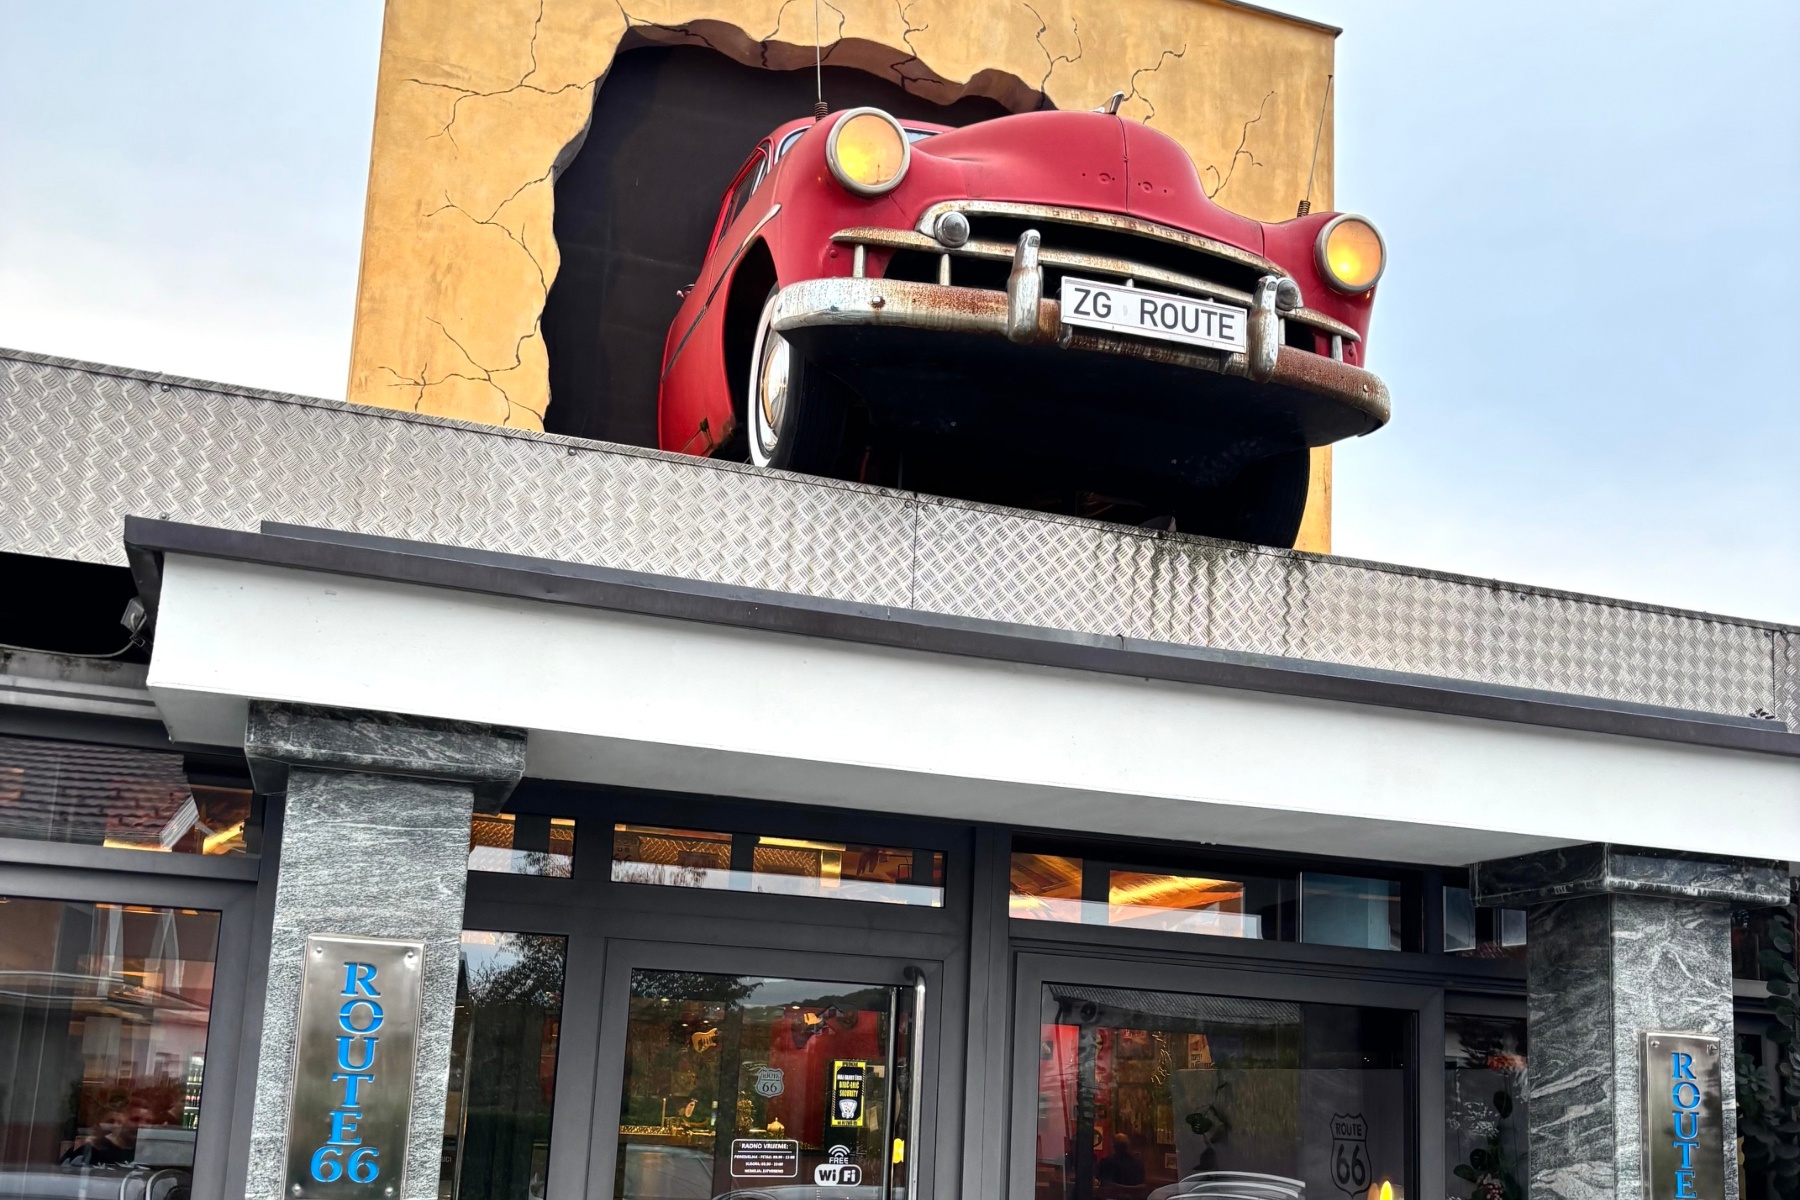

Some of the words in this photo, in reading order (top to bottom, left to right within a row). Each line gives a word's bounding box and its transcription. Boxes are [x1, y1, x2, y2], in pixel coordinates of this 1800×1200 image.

[1073, 287, 1112, 319] ZG
[1139, 298, 1235, 341] ROUTE
[326, 961, 384, 1145] ROUTE
[762, 1082, 778, 1093] 66
[1335, 1122, 1363, 1137] ROUTE
[1671, 1052, 1701, 1199] ROUTE
[310, 1146, 380, 1184] 66
[828, 1156, 849, 1165] FREE
[1336, 1143, 1366, 1187] 66
